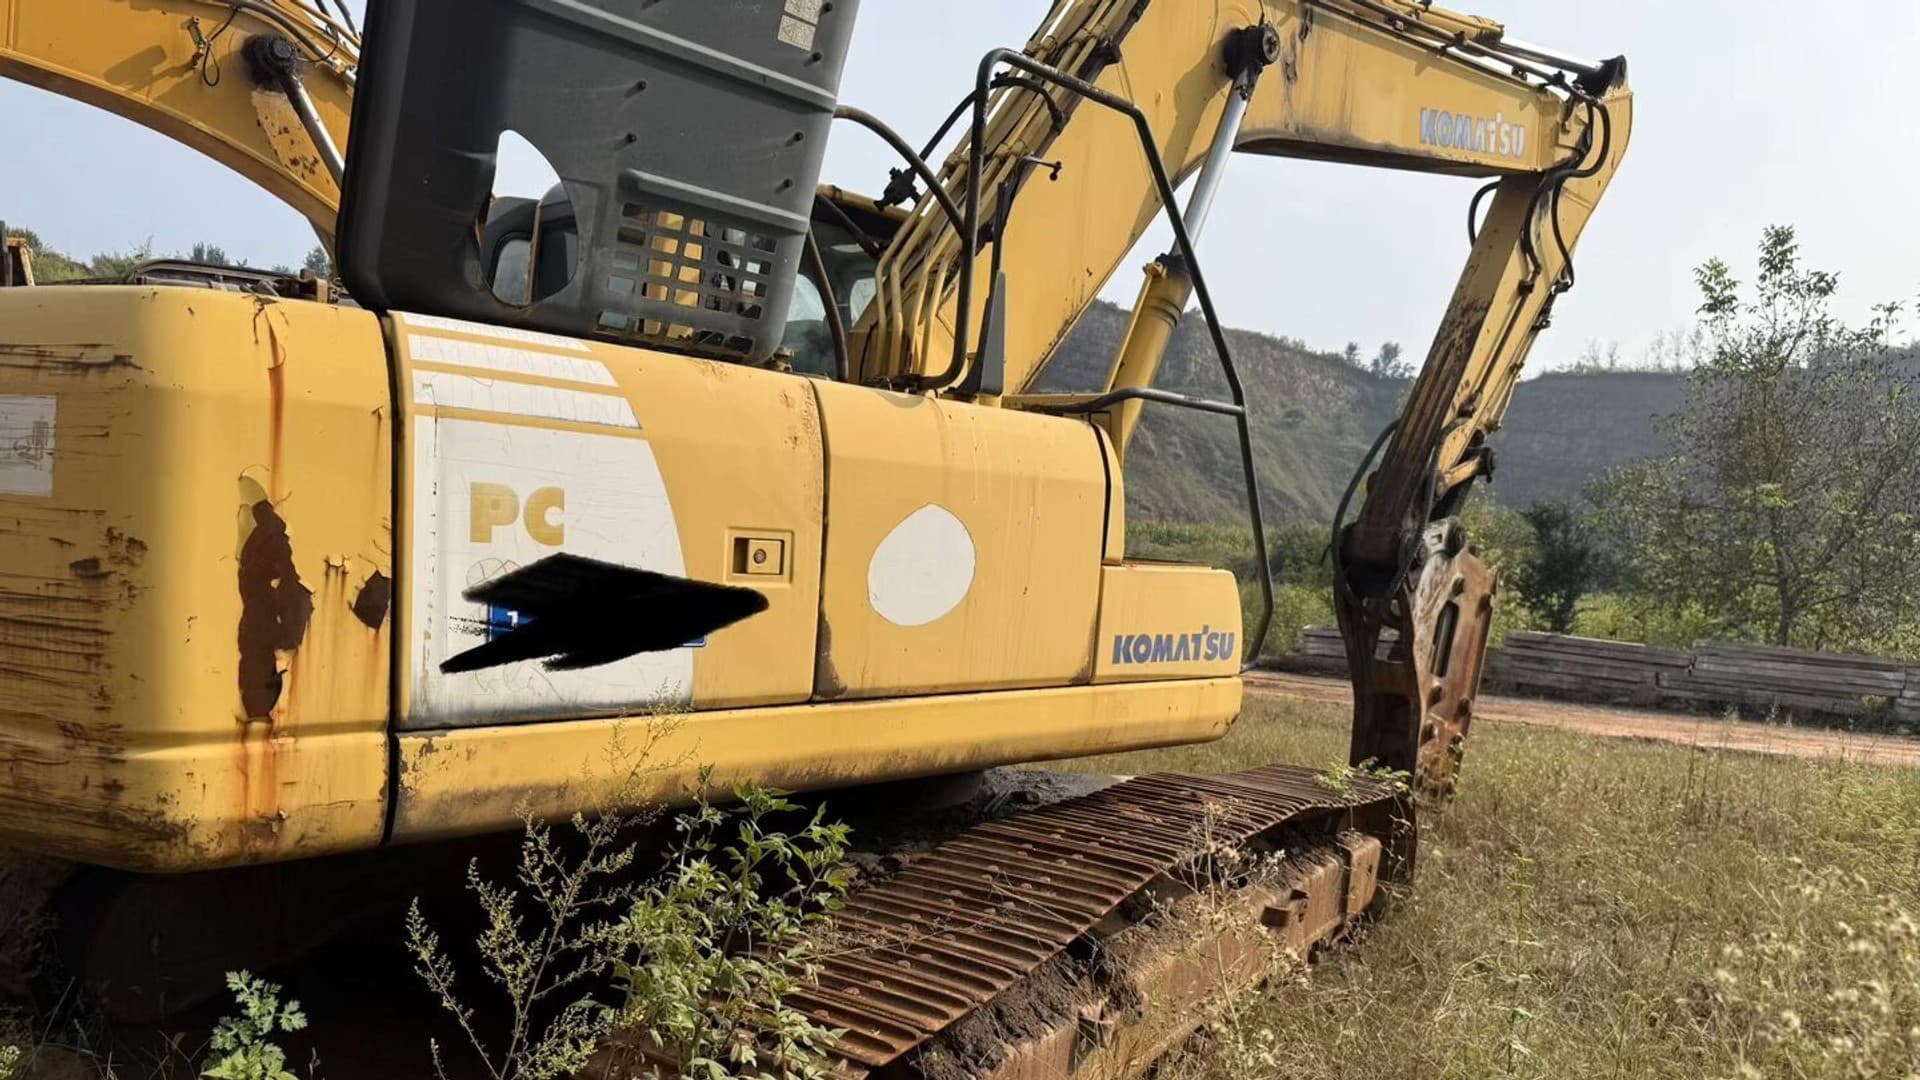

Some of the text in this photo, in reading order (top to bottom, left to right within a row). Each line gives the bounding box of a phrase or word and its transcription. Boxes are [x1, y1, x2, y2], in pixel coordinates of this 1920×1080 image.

[1419, 107, 1526, 158] KOMATSU
[470, 482, 565, 546] PC
[1112, 625, 1235, 664] KOMATSU
